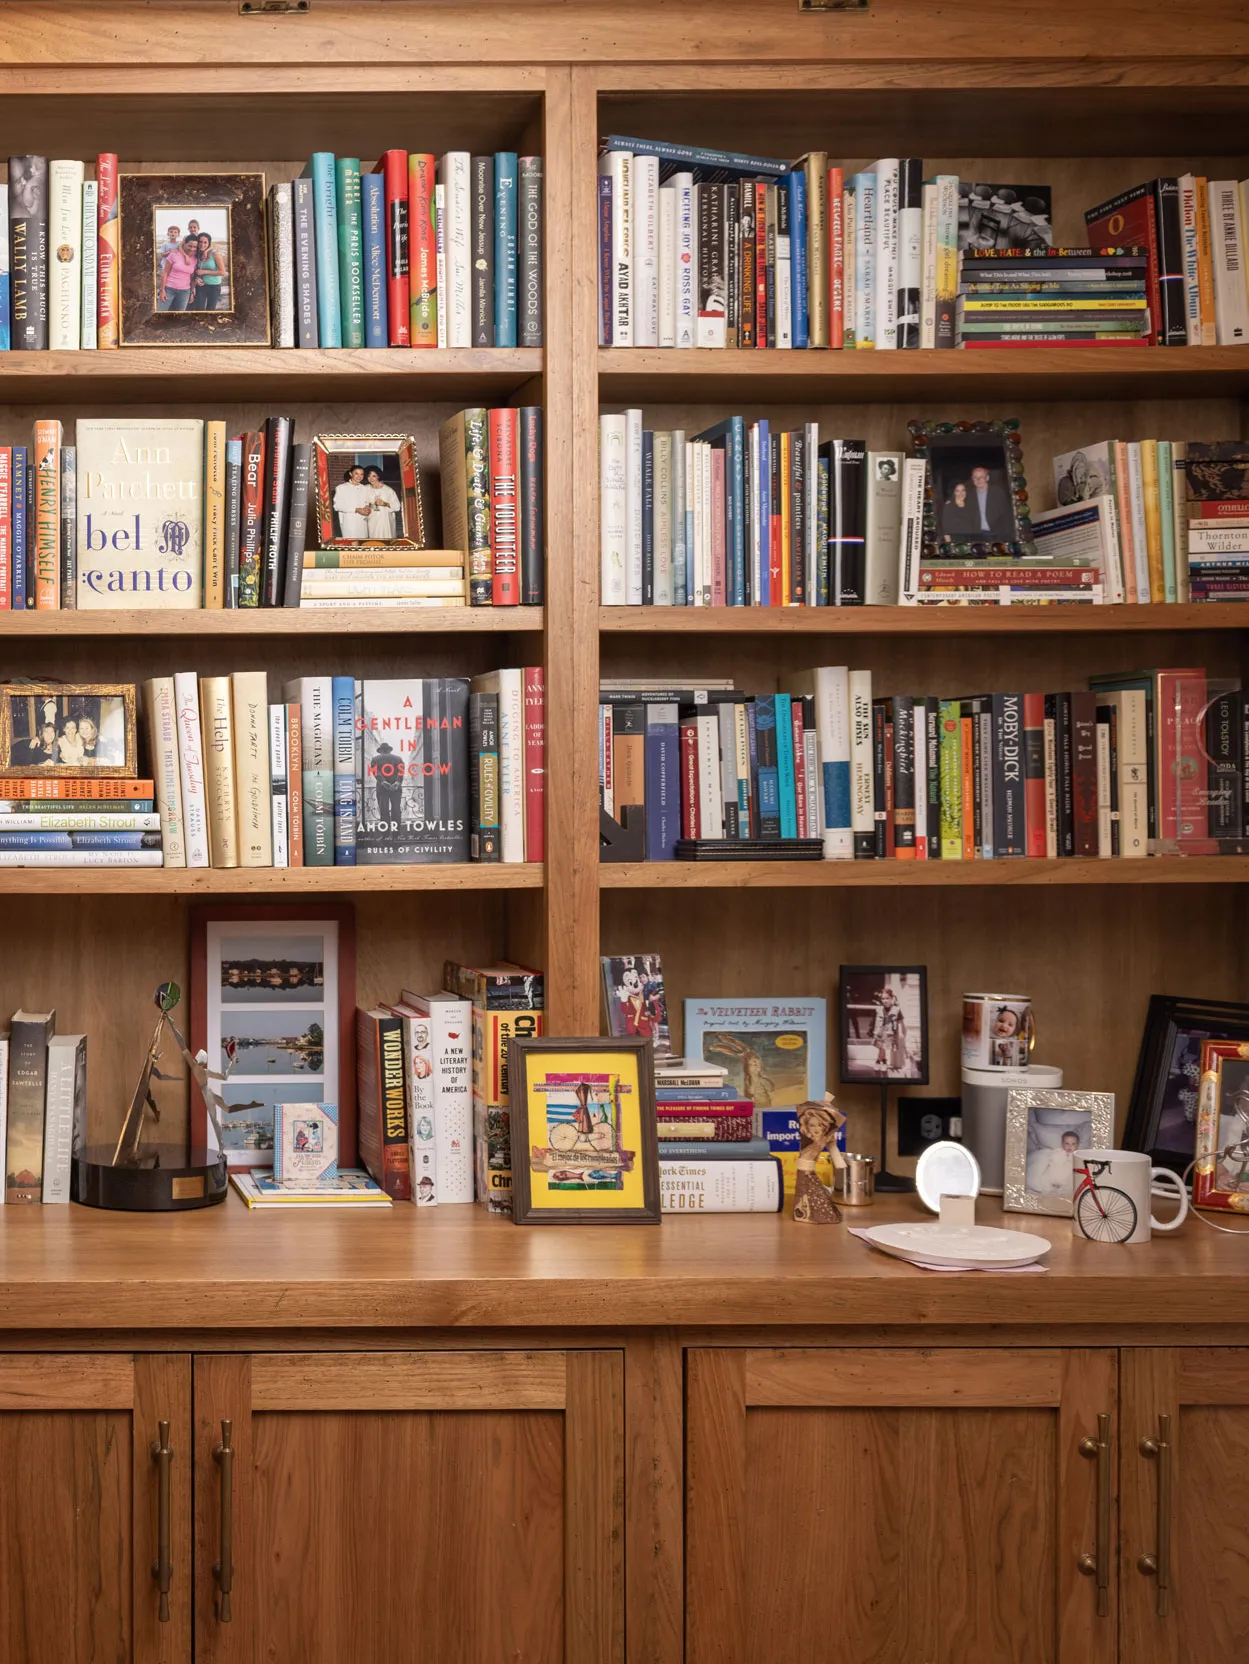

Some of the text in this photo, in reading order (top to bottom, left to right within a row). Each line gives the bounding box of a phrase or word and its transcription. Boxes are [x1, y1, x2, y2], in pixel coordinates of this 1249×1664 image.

[743, 183, 753, 208] HAMILL
[351, 230, 359, 257] PARIS
[528, 185, 538, 315] THE GOD OF THE WOODS
[1221, 190, 1239, 271] THREE BY ANNIE DILLARD
[14, 222, 27, 320] WALLY LAMB
[31, 252, 38, 261] IS
[300, 209, 311, 324] THE EVENING SHADES
[370, 186, 381, 320] Absolution Alice McDermott
[682, 187, 691, 316] INCITING JOY ROSS GAY
[743, 251, 752, 292] DRINKING
[942, 222, 952, 292] brown girl dreaming
[1183, 189, 1199, 319] Didion The White Album
[351, 262, 361, 324] BOOKSELLER
[420, 248, 429, 318] James McBride
[618, 263, 630, 327] AYAD AKHTAR
[743, 295, 752, 313] LIFE
[112, 436, 170, 464] Ann
[470, 421, 483, 445] Life,
[248, 454, 260, 487] Bear
[473, 448, 483, 461] &
[84, 471, 199, 499] Patchett
[474, 498, 484, 509] &
[15, 454, 23, 589] HAMNET MAGGIE O'FARRELL
[38, 469, 57, 585] HENRY, HIMSELF
[84, 513, 143, 551] bel
[244, 502, 257, 563] Julia Phillips
[269, 512, 279, 570] PHILIP ROTH
[475, 513, 486, 547] Giants
[495, 474, 516, 574] THE VOLUNTEER
[1197, 531, 1248, 541] Thornton
[1207, 541, 1243, 551] Wilder
[83, 567, 193, 595] canto
[402, 695, 413, 708] A
[855, 695, 863, 746] ALSO RISES
[862, 703, 870, 739] THE SUN
[211, 696, 229, 752] The Help
[313, 687, 322, 766] THE MAGICIAN
[354, 715, 463, 731] GENTLEMAN
[896, 708, 908, 774] Mockingbird
[1004, 697, 1020, 782] MOBY-DICK
[1220, 701, 1229, 756] LEO TOLSTOY
[290, 718, 299, 771] BROOKLYN
[400, 739, 417, 752] IN
[501, 712, 510, 795] ANNE TYLER
[512, 690, 521, 817] DIGGING TO AMERICA
[337, 698, 353, 842] COLM TÓIBÍN LONG ISLAND
[366, 762, 452, 777] MOSCOW
[356, 819, 464, 832] AMOR TOWLES
[397, 846, 410, 854] OF
[414, 846, 453, 854] CIVILITY
[709, 1006, 815, 1017] VELVETEEN RABBIT
[383, 1029, 405, 1138] WONDERWORKS
[450, 1076, 458, 1084] OF
[661, 1181, 705, 1191] ESSENTIAL
[678, 1165, 707, 1176] Times
[661, 1193, 705, 1209] LEDGE
